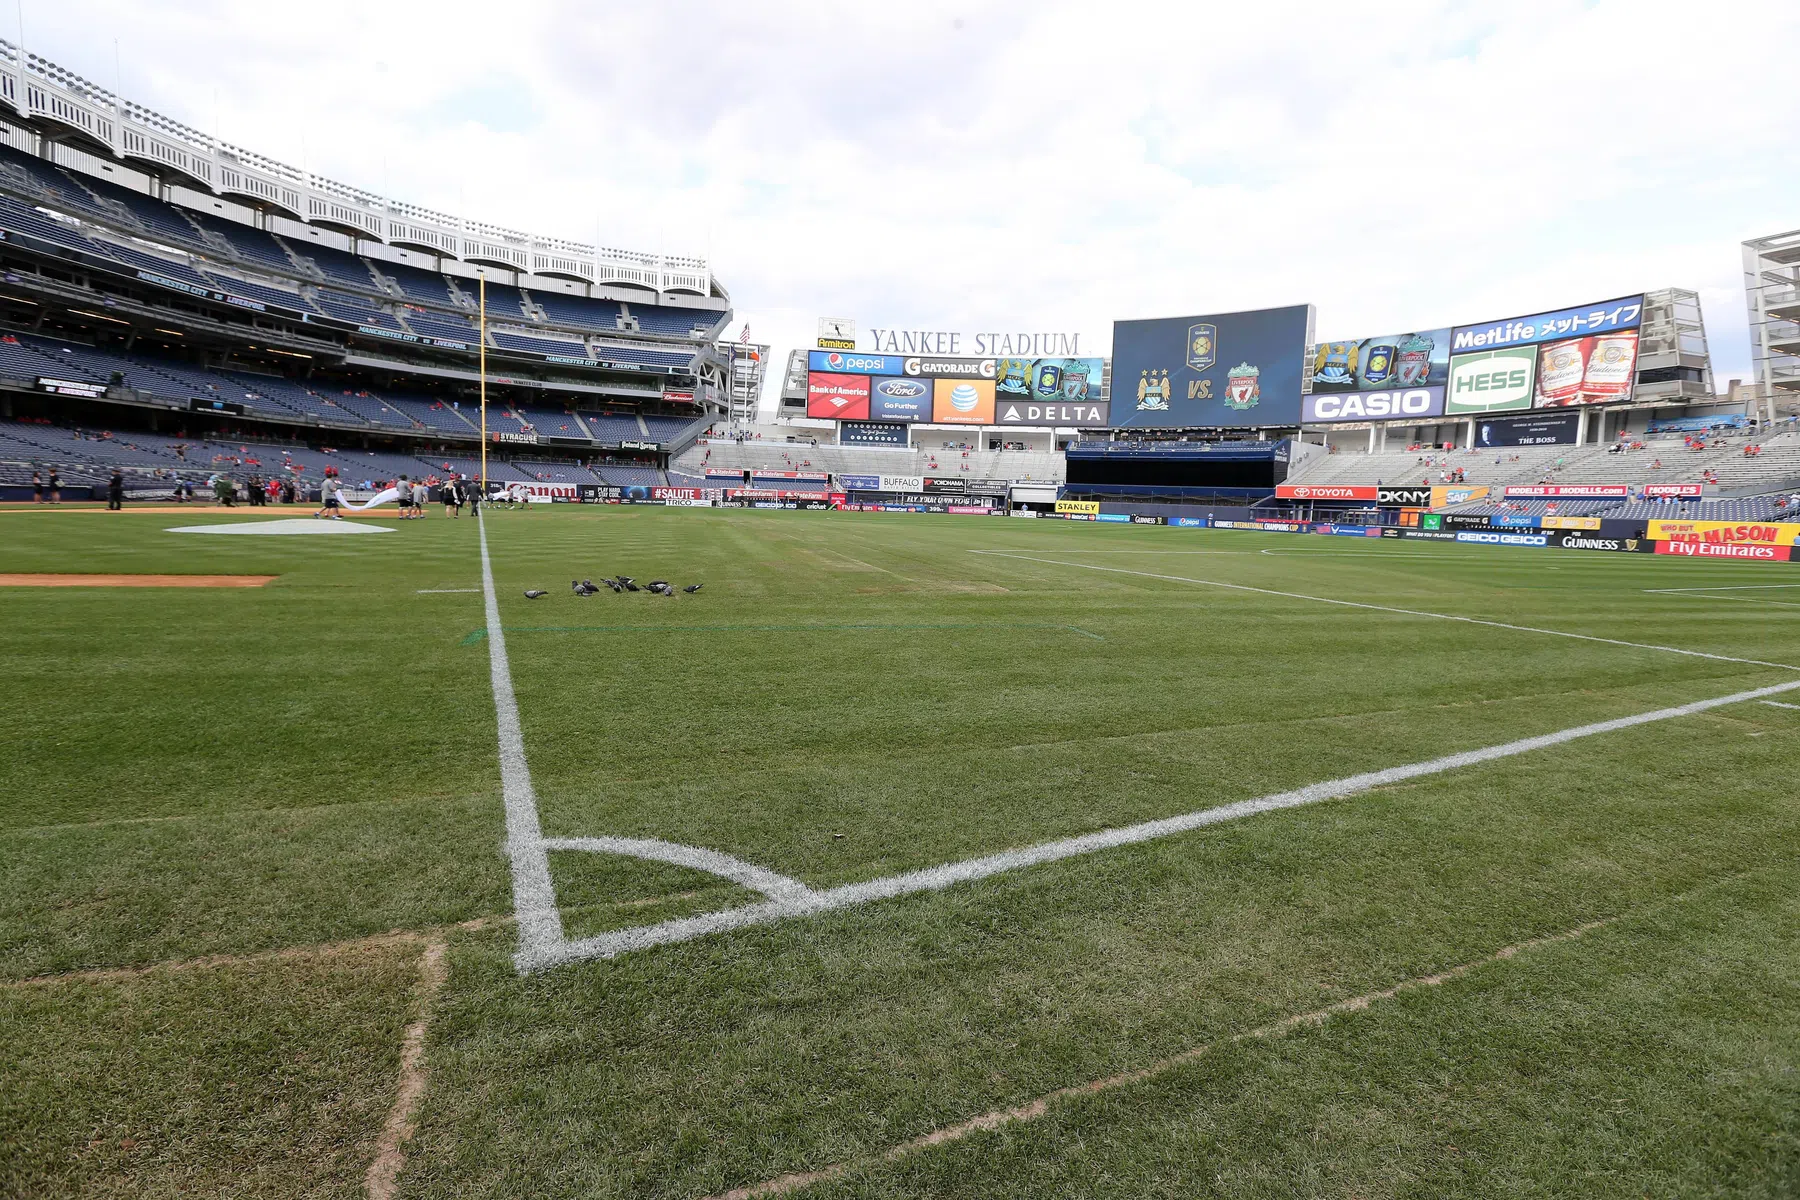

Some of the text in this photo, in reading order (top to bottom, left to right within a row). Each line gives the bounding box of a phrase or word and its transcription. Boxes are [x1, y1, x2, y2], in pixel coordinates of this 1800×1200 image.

[137, 271, 190, 292] MANCHESTER
[190, 286, 208, 296] CITY
[226, 296, 265, 311] LIVERPOOL
[1454, 304, 1641, 349] MetLife メットライフ
[358, 326, 402, 339] MANCHESTER
[433, 340, 466, 350] LIVERPOOL
[819, 339, 854, 349] Armitron
[870, 329, 1080, 355] YANKEE STADIUM
[546, 356, 584, 364] MANCHESTER
[846, 358, 884, 371] pepsi
[922, 363, 978, 373] GATORADE
[1456, 370, 1526, 393] HESS
[838, 387, 868, 396] America
[887, 382, 916, 396] Ford
[1188, 380, 1213, 399] VS.
[1315, 390, 1430, 418] CASIO
[1028, 407, 1100, 420] DELTA
[501, 433, 538, 441] SYRACUSE
[640, 442, 657, 451] Spring
[884, 478, 919, 486] BUFFALO
[507, 484, 575, 499] Canon
[655, 489, 694, 499] #SALUTE
[1312, 488, 1353, 496] TOYOTA
[1648, 486, 1696, 494] MODELL'S
[1378, 491, 1430, 502] DKNY
[1446, 492, 1469, 502] SAP
[1135, 516, 1155, 524] GUINNESS
[1264, 523, 1289, 531] CHAMPIONS
[1457, 533, 1546, 545] GEICO GEICO
[1704, 526, 1780, 542] MASON
[1562, 536, 1620, 550] GUINNESS
[1669, 542, 1774, 557] Fly Emirates
